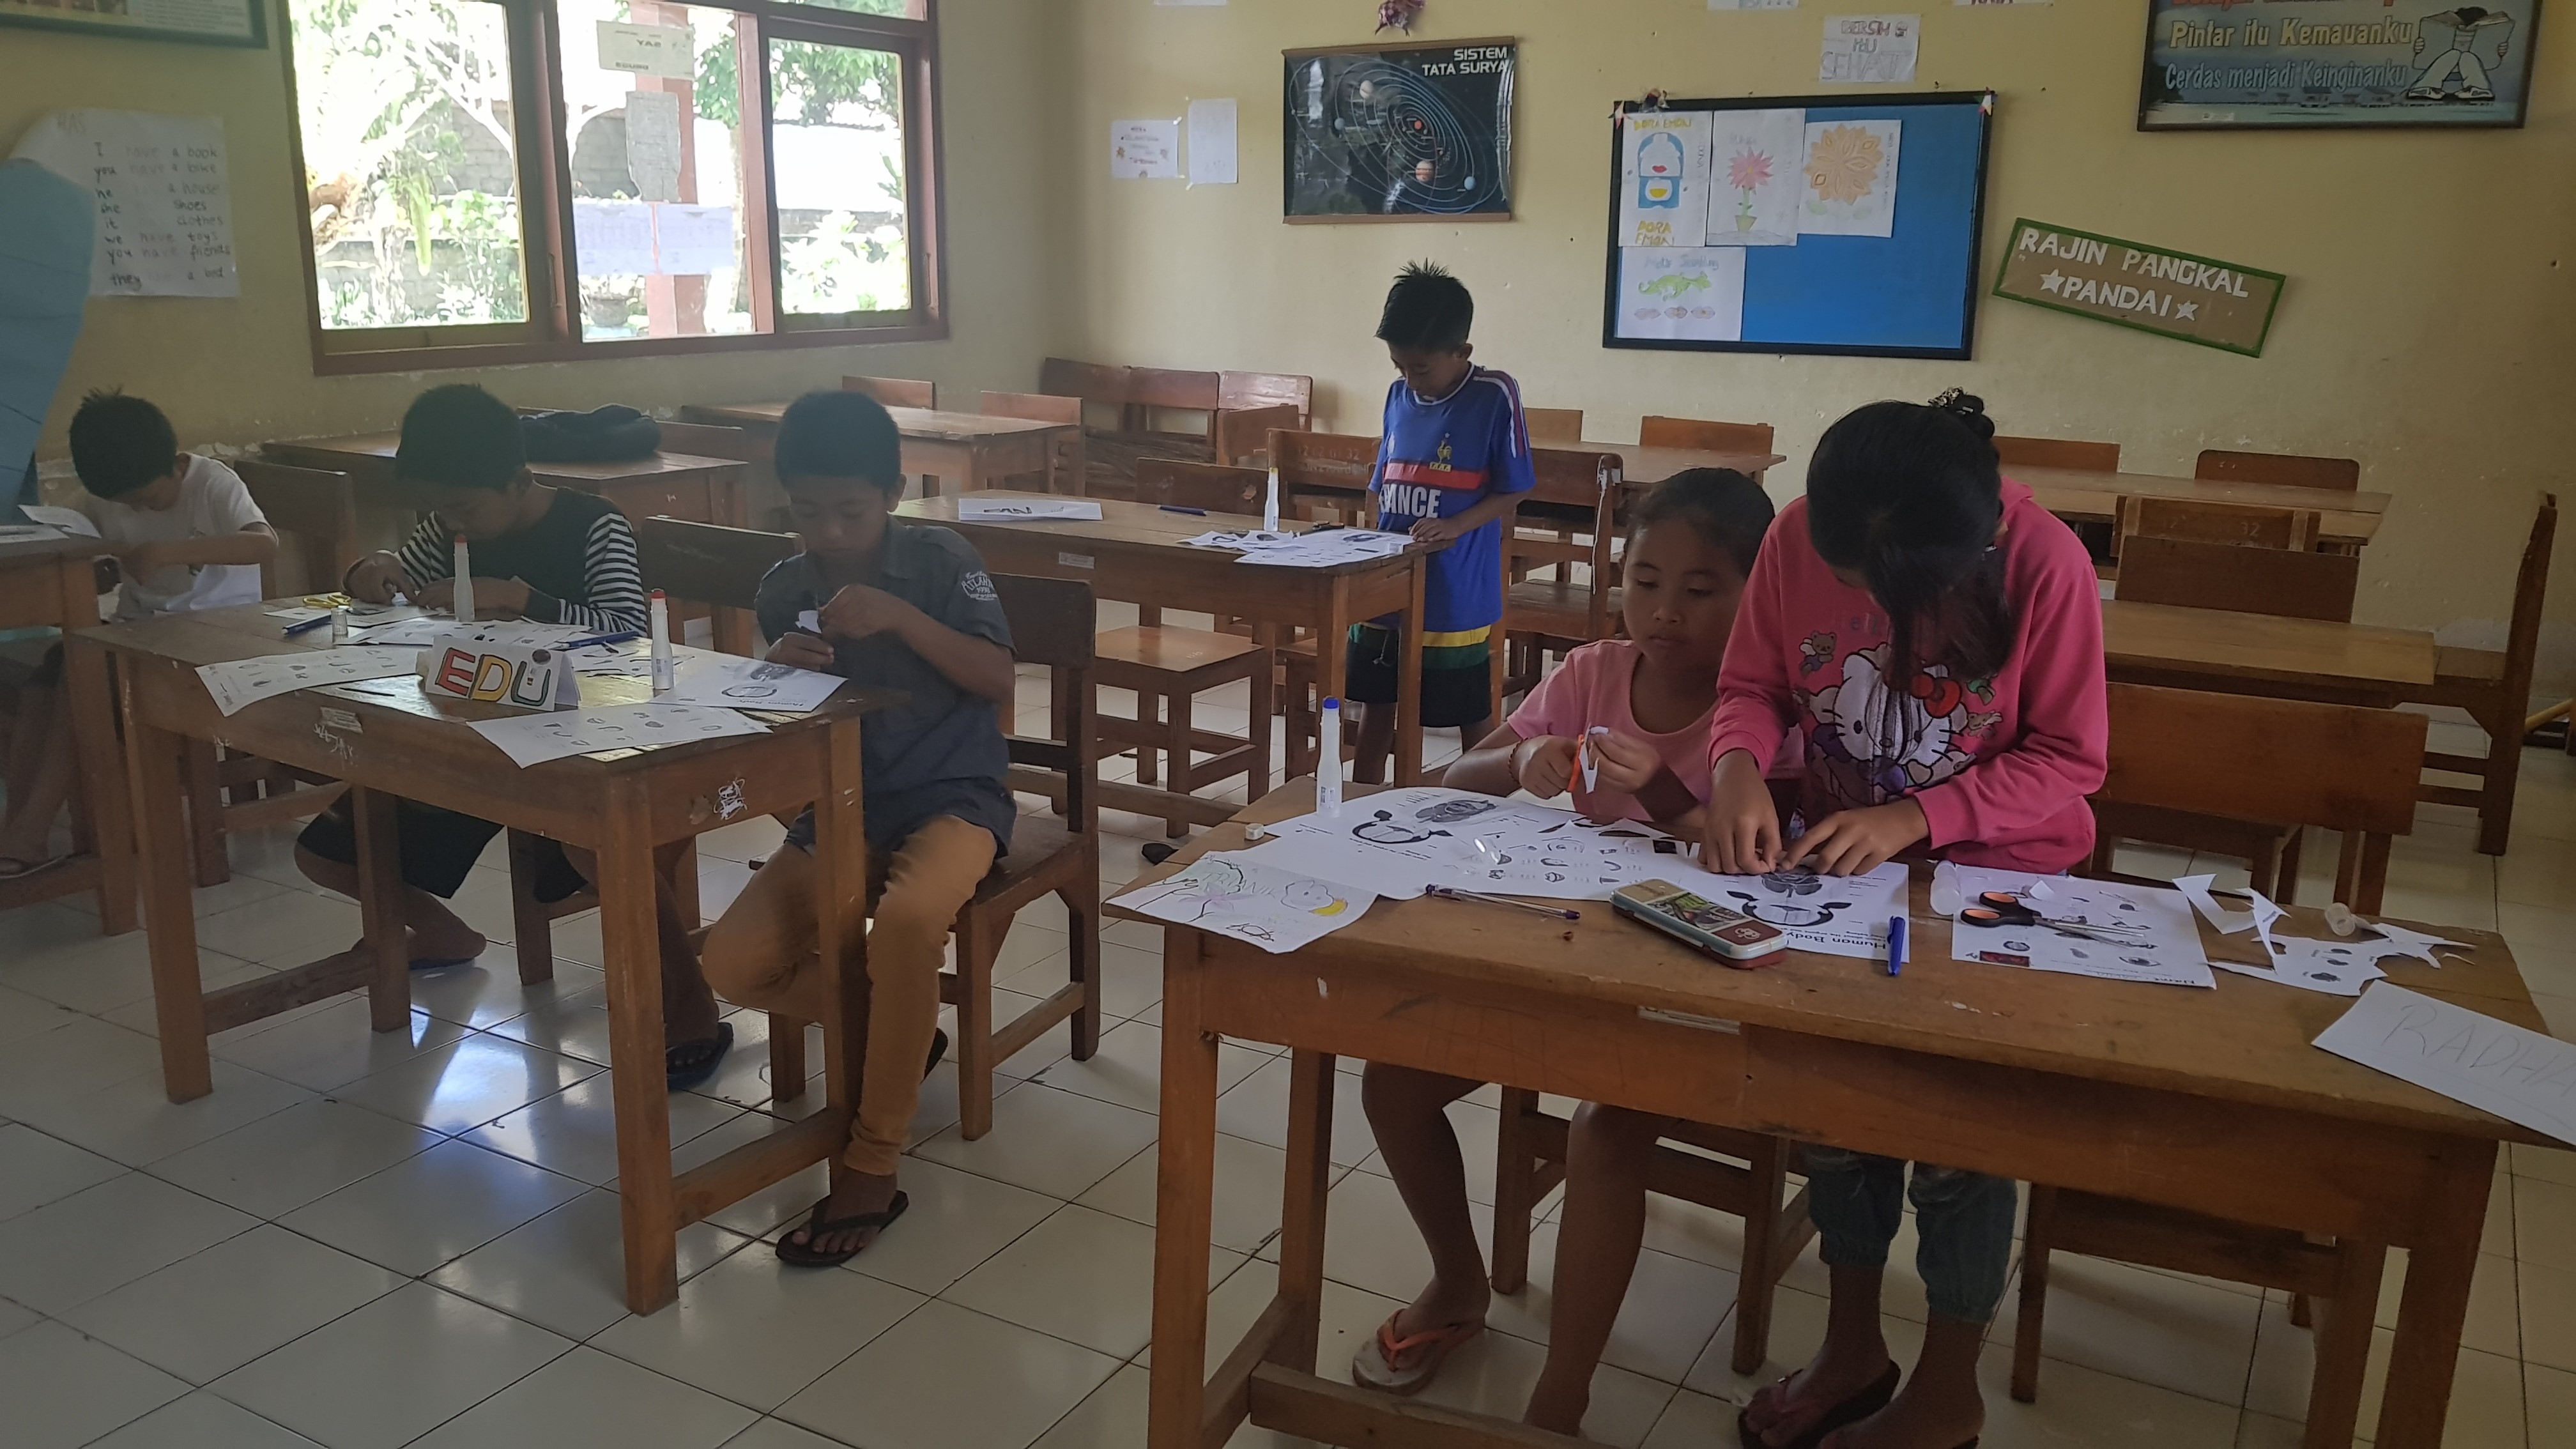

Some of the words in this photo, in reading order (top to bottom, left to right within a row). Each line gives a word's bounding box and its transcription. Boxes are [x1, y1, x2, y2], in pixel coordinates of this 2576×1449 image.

[2170, 20, 2235, 48] Pintar
[2244, 18, 2270, 47] itu
[2280, 15, 2412, 46] Kemauanku
[1454, 47, 1507, 61] SISTEM
[1422, 63, 1455, 76] TATA
[1460, 61, 1508, 74] SURYA
[2166, 63, 2221, 90] Cerdas
[2227, 61, 2296, 93] menjadi
[2301, 59, 2407, 92] Keinginanku
[94, 141, 103, 158] I
[187, 143, 217, 158] book
[94, 166, 117, 183] you
[188, 162, 217, 174] bike
[176, 215, 224, 227] clothes
[188, 232, 218, 245] toys
[107, 249, 133, 266] you
[190, 244, 231, 261] friends
[2019, 227, 2108, 265] RAJIN
[2122, 249, 2249, 298] PANGKAL
[110, 273, 142, 291] they
[2062, 276, 2172, 318] PANDAI
[435, 647, 551, 706] EDU
[1786, 932, 1825, 944] Body
[1832, 937, 1887, 949] Human
